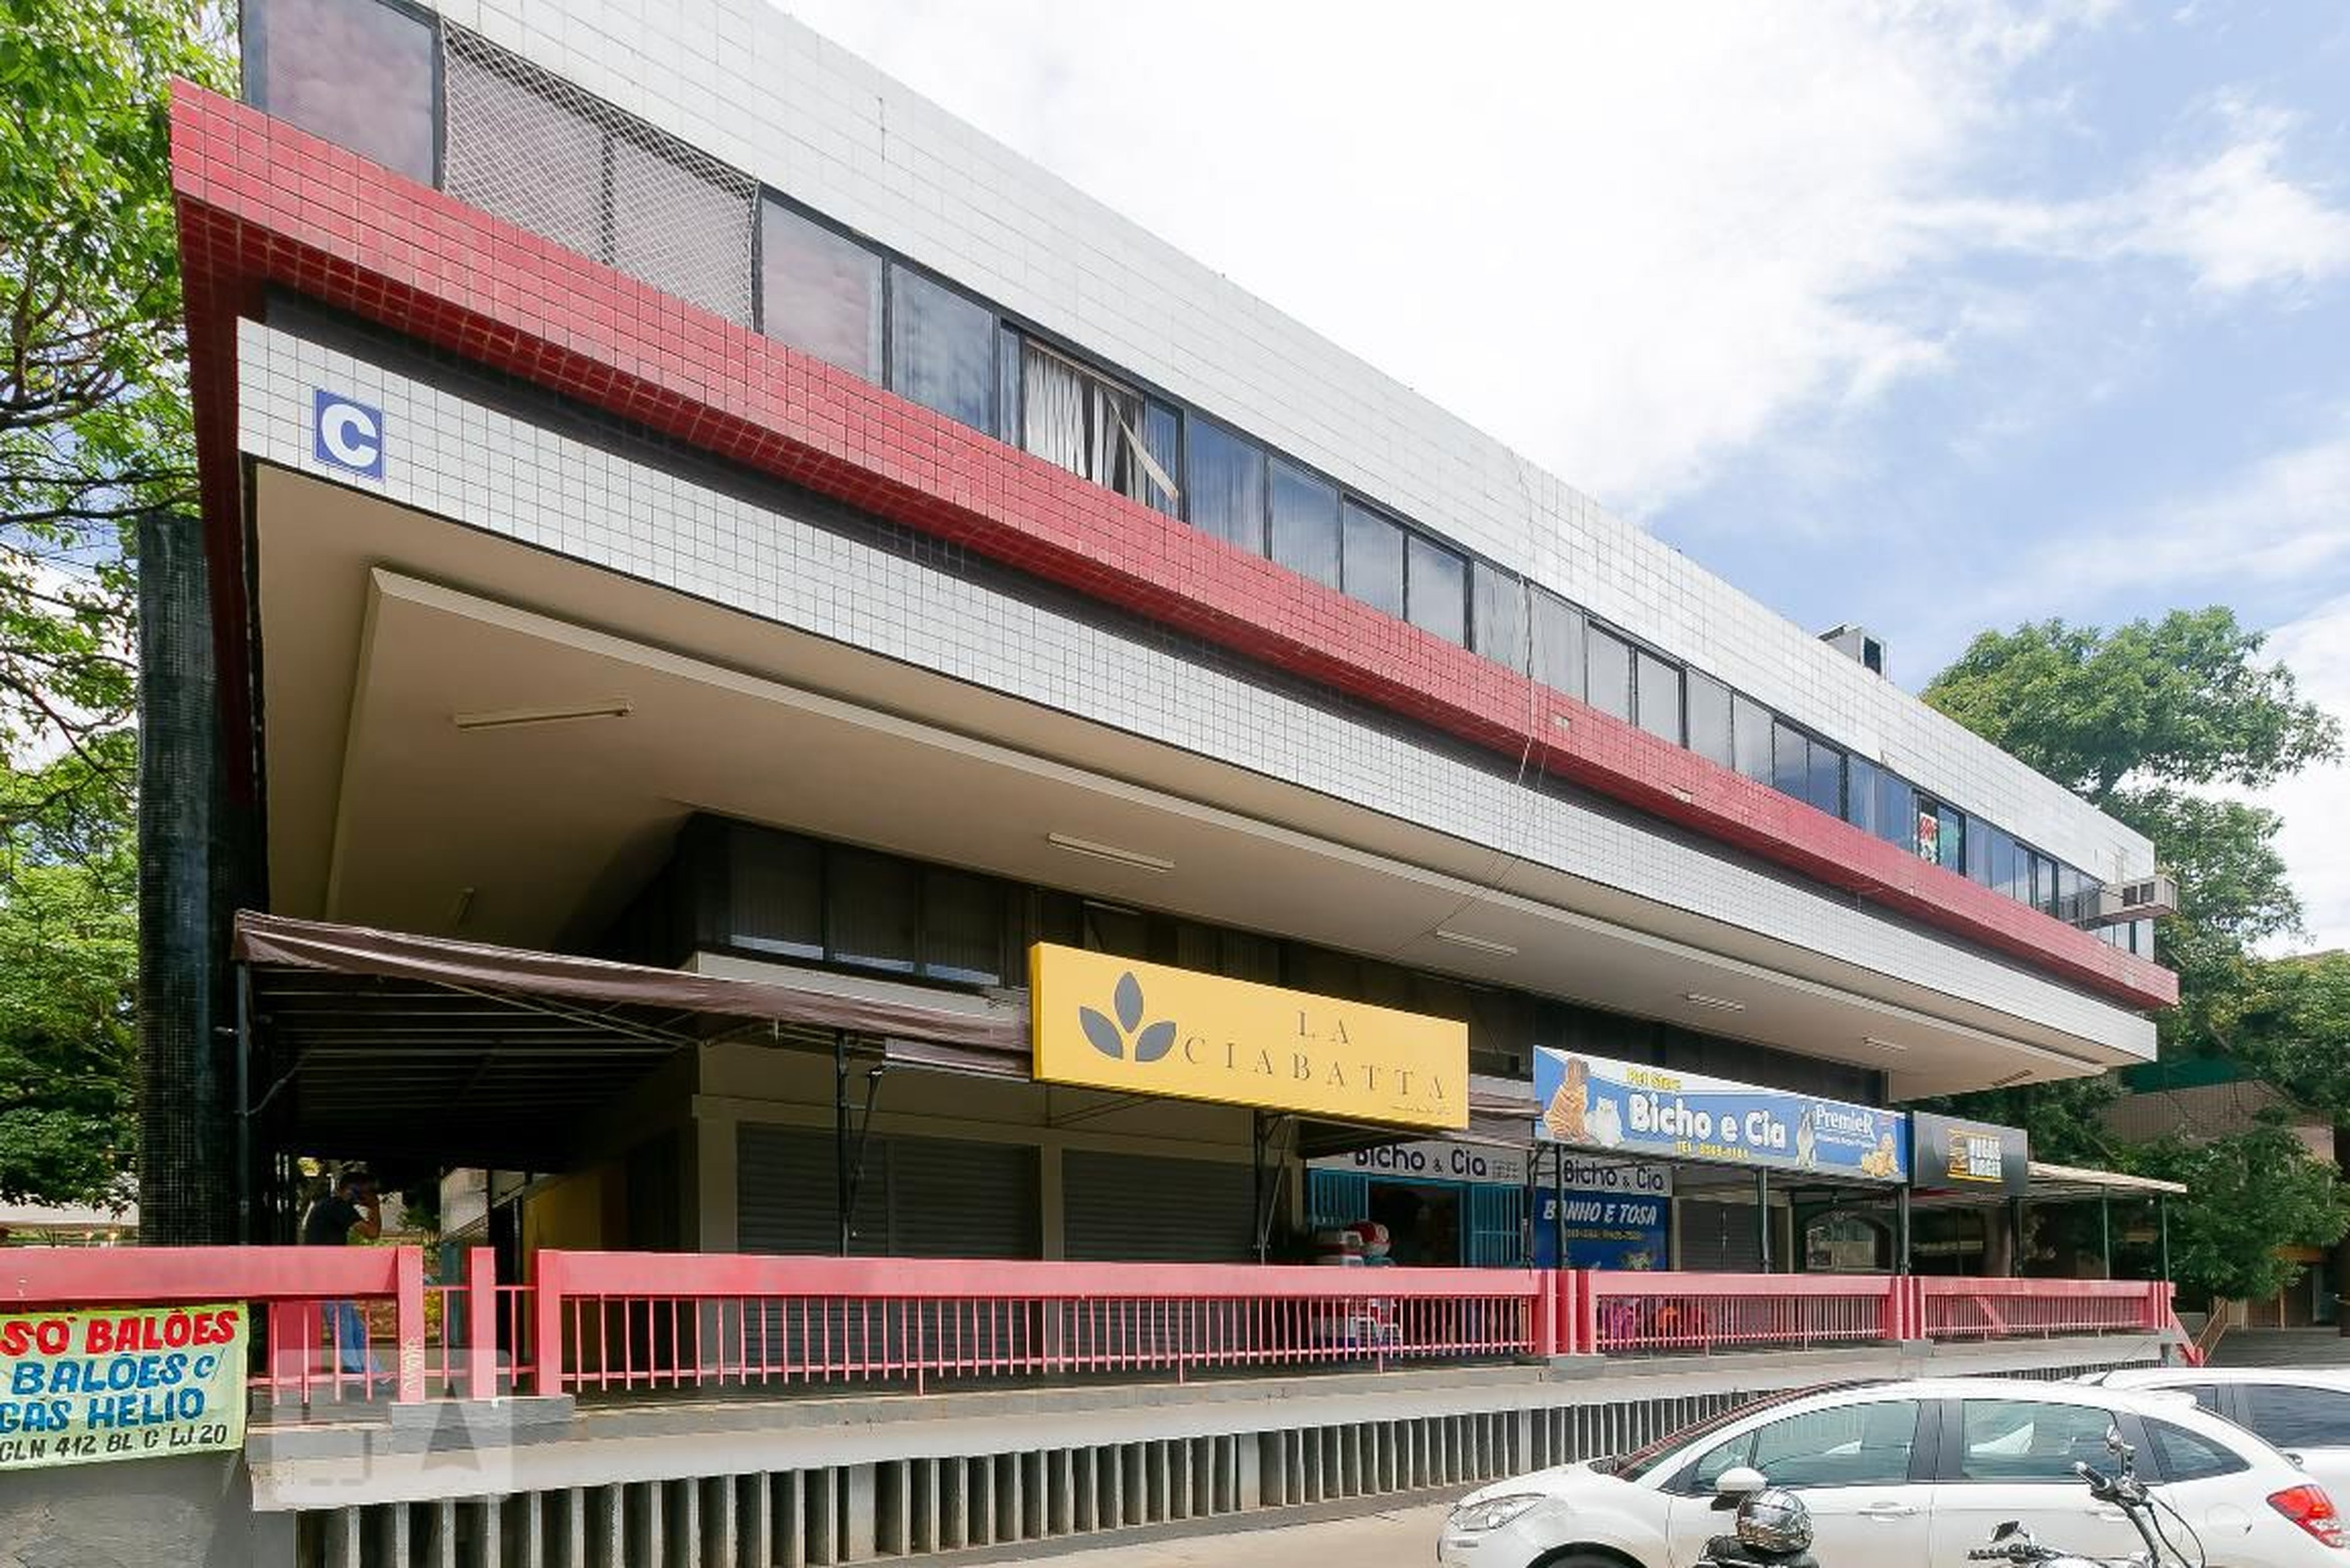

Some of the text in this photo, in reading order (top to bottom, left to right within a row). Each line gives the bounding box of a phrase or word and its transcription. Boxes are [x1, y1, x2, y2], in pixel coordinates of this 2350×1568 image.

[321, 403, 378, 468] C
[1297, 1011, 1351, 1044] LA
[1185, 1036, 1445, 1099] CIABATTA
[1628, 1092, 1786, 1149] Bicho e Cia
[1451, 1149, 1486, 1176] Cia
[1564, 1160, 1617, 1186] Bicho
[1636, 1167, 1663, 1189] Cia
[1603, 1203, 1616, 1223] E
[1619, 1204, 1657, 1225] TOSA
[88, 1387, 205, 1430] HELIO
[0, 1439, 47, 1462] CLN
[54, 1435, 97, 1457] 412
